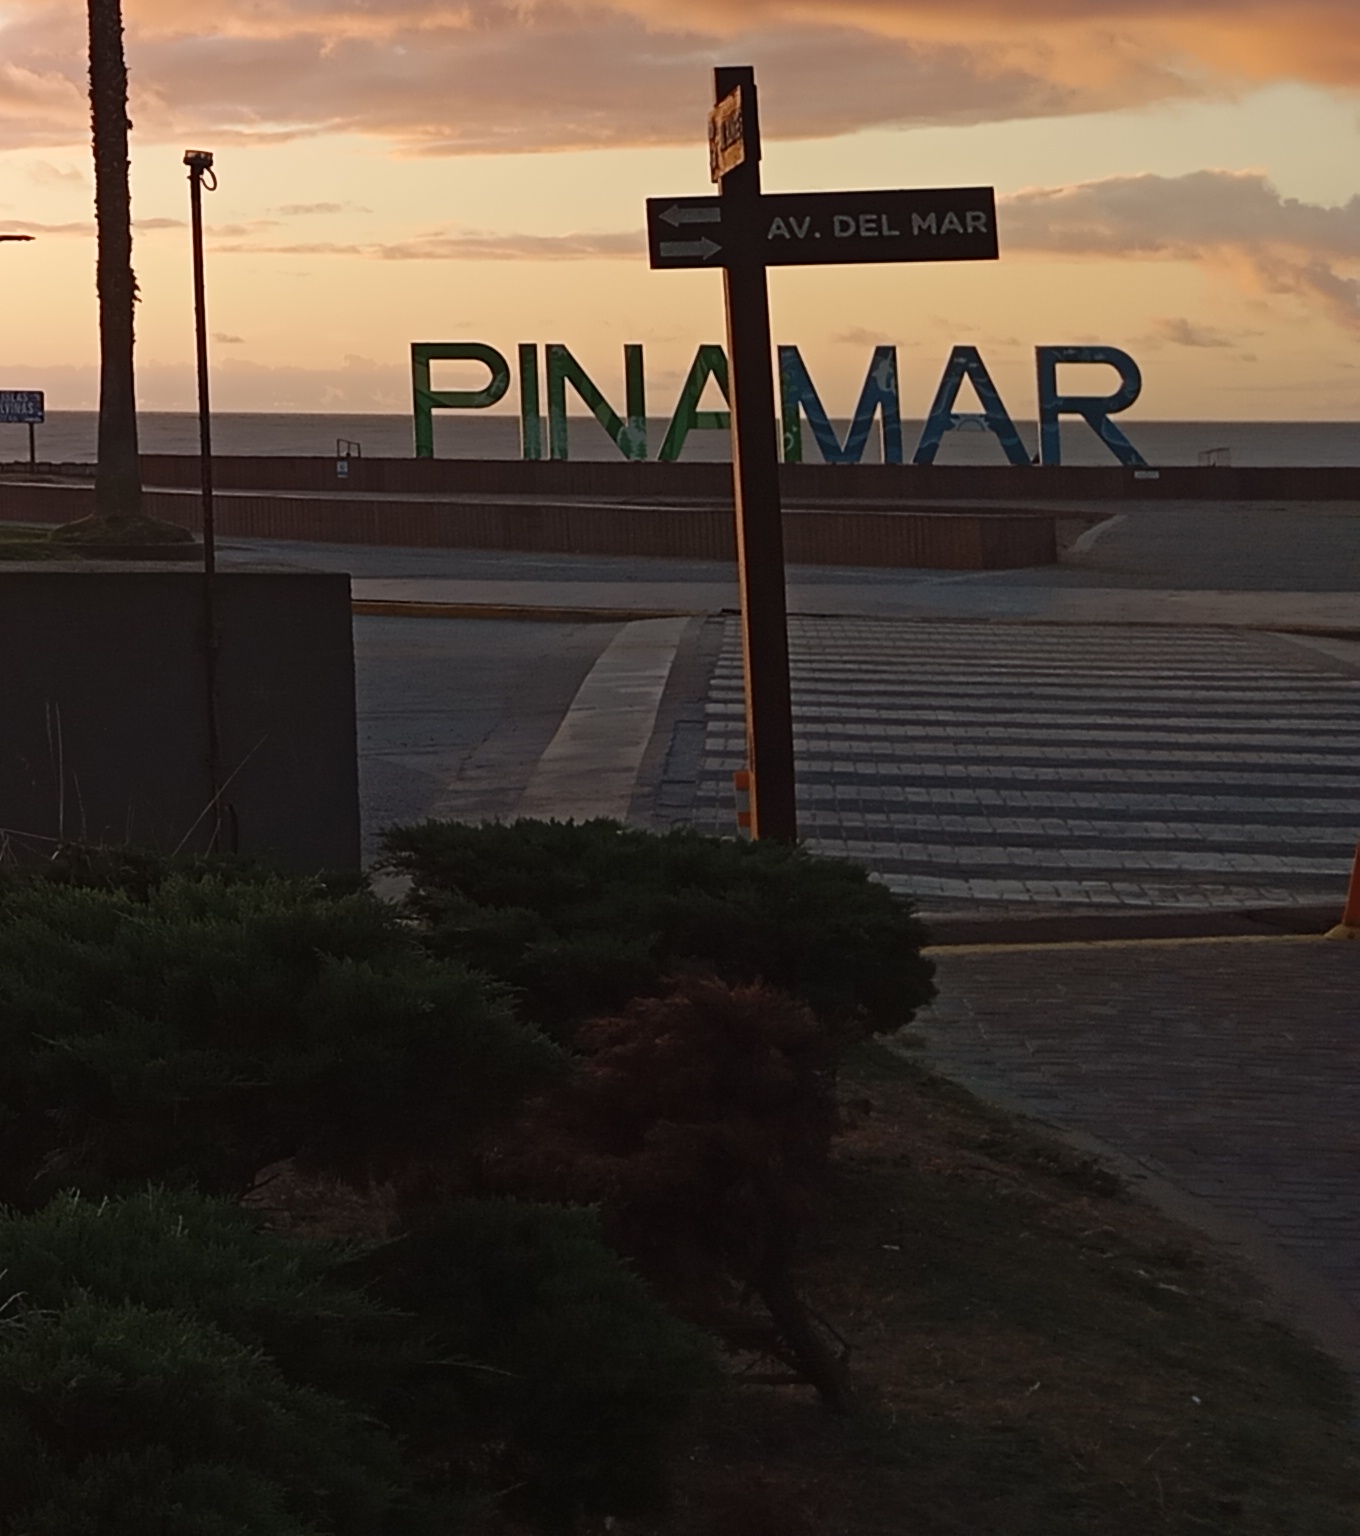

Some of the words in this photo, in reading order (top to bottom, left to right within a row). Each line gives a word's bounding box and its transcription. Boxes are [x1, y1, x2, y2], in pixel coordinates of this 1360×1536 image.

[766, 215, 822, 240] AV.
[833, 214, 901, 238] DEL
[911, 210, 988, 236] MAR
[409, 341, 1148, 466] PINAMAR
